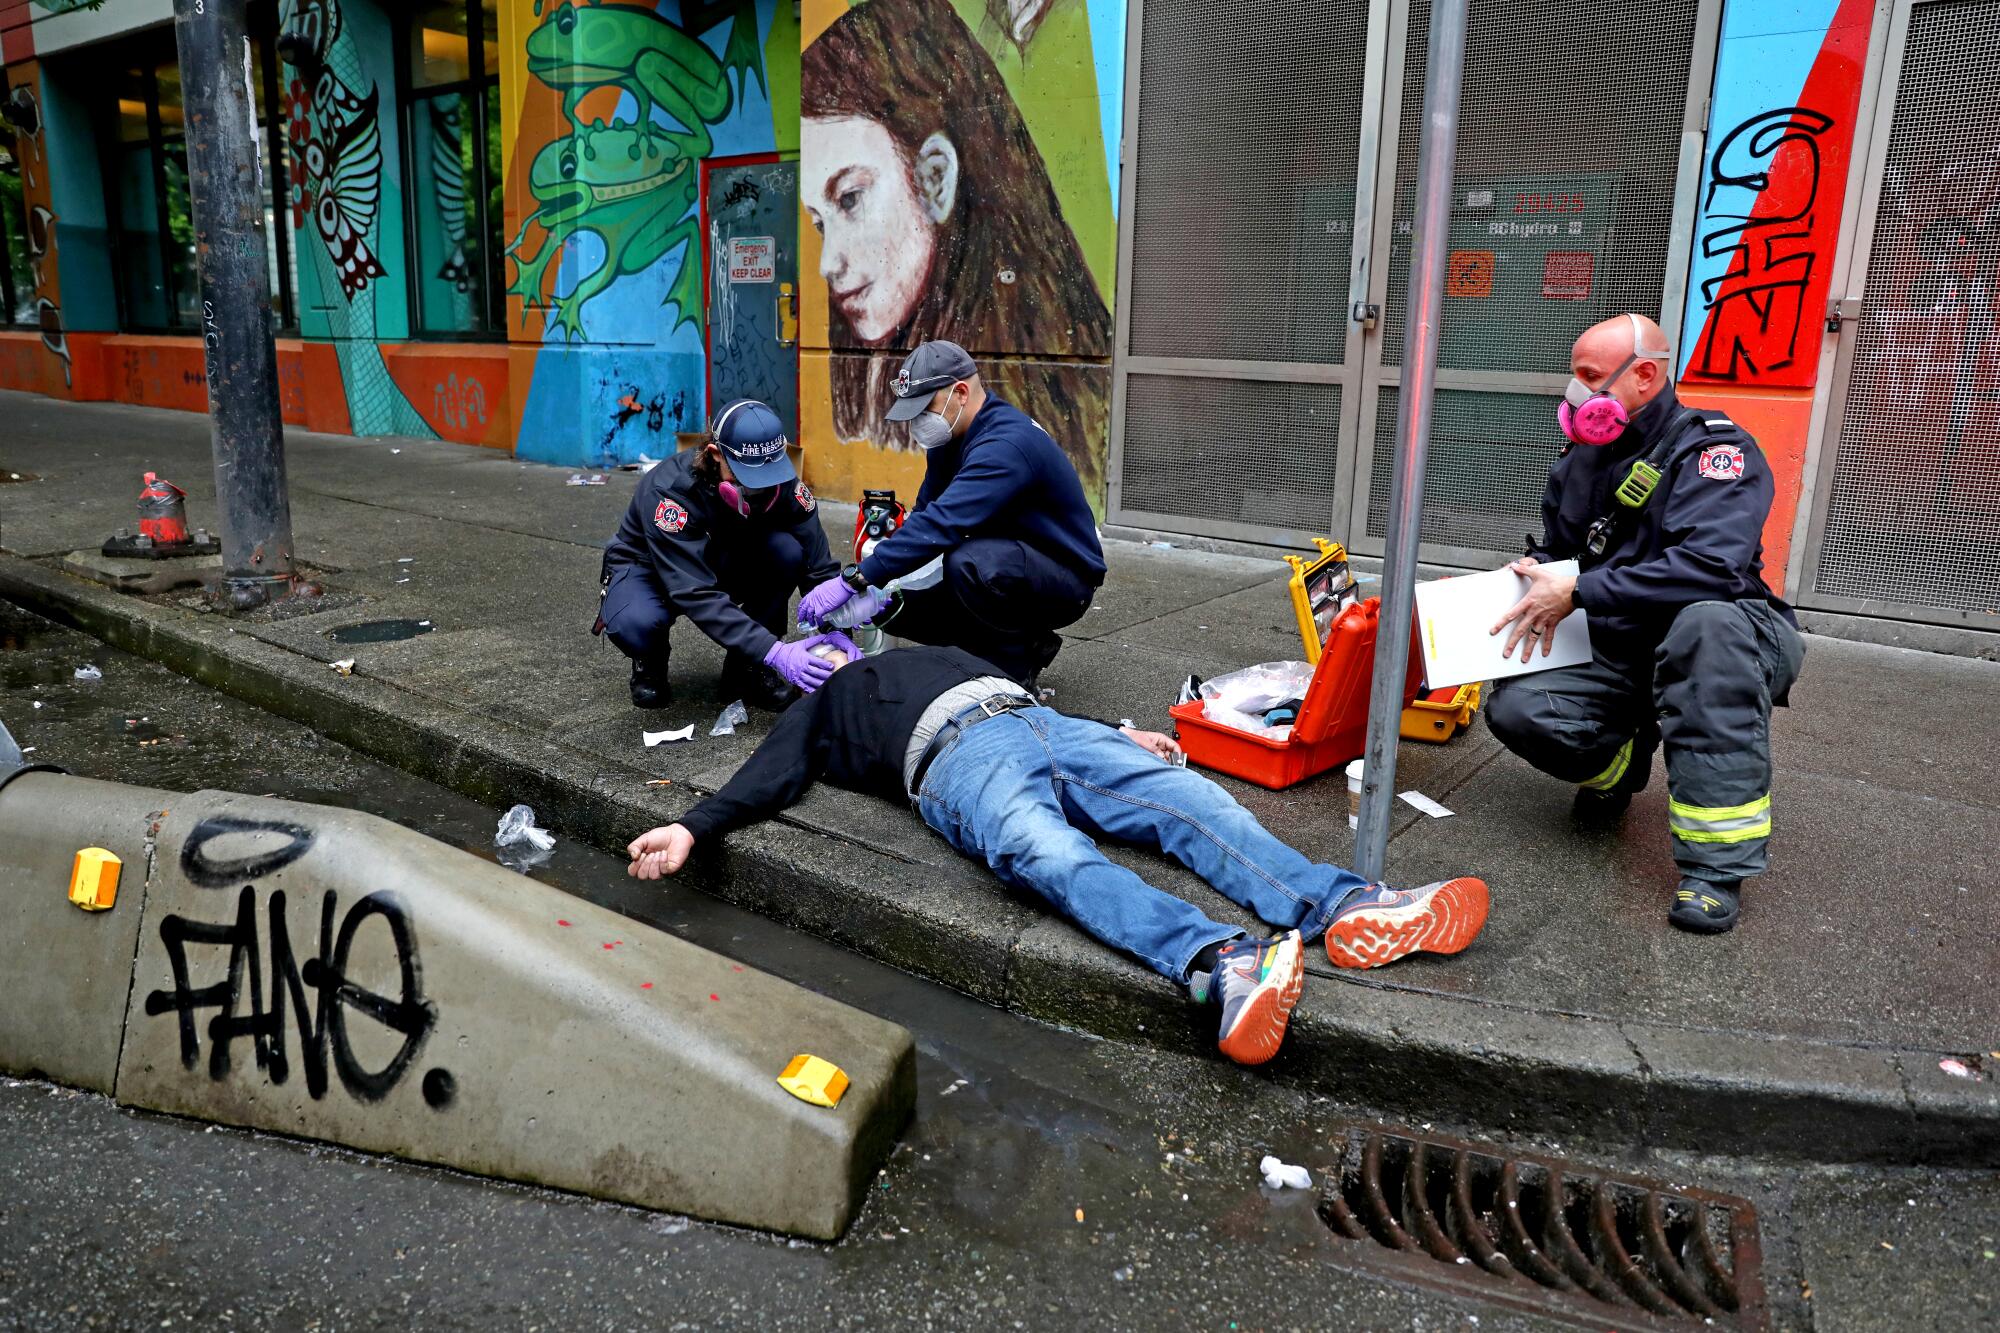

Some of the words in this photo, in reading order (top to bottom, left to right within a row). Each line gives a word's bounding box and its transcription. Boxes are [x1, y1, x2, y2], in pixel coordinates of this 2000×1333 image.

[1512, 191, 1585, 214] 29425
[735, 243, 768, 255] Emergency
[743, 256, 759, 266] EXIT
[732, 268, 749, 278] KEEP
[750, 268, 772, 278] CLEAR
[742, 447, 760, 455] FIRE
